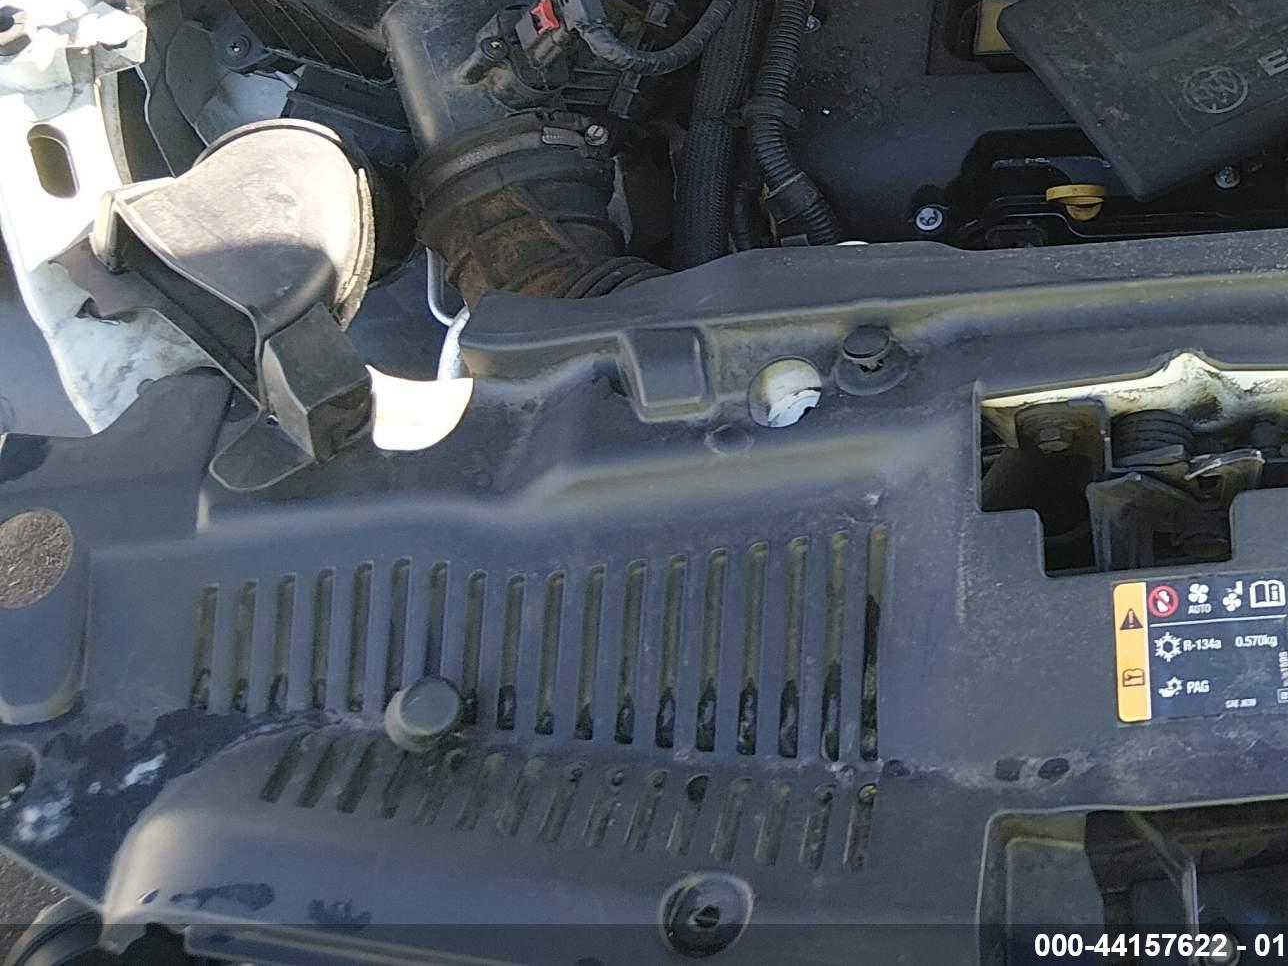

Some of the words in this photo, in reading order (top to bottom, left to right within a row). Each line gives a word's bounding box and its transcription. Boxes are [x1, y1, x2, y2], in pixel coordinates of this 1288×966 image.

[1187, 604, 1211, 614] AUTO
[1183, 638, 1222, 650] R-134a
[1187, 681, 1210, 694] PAG
